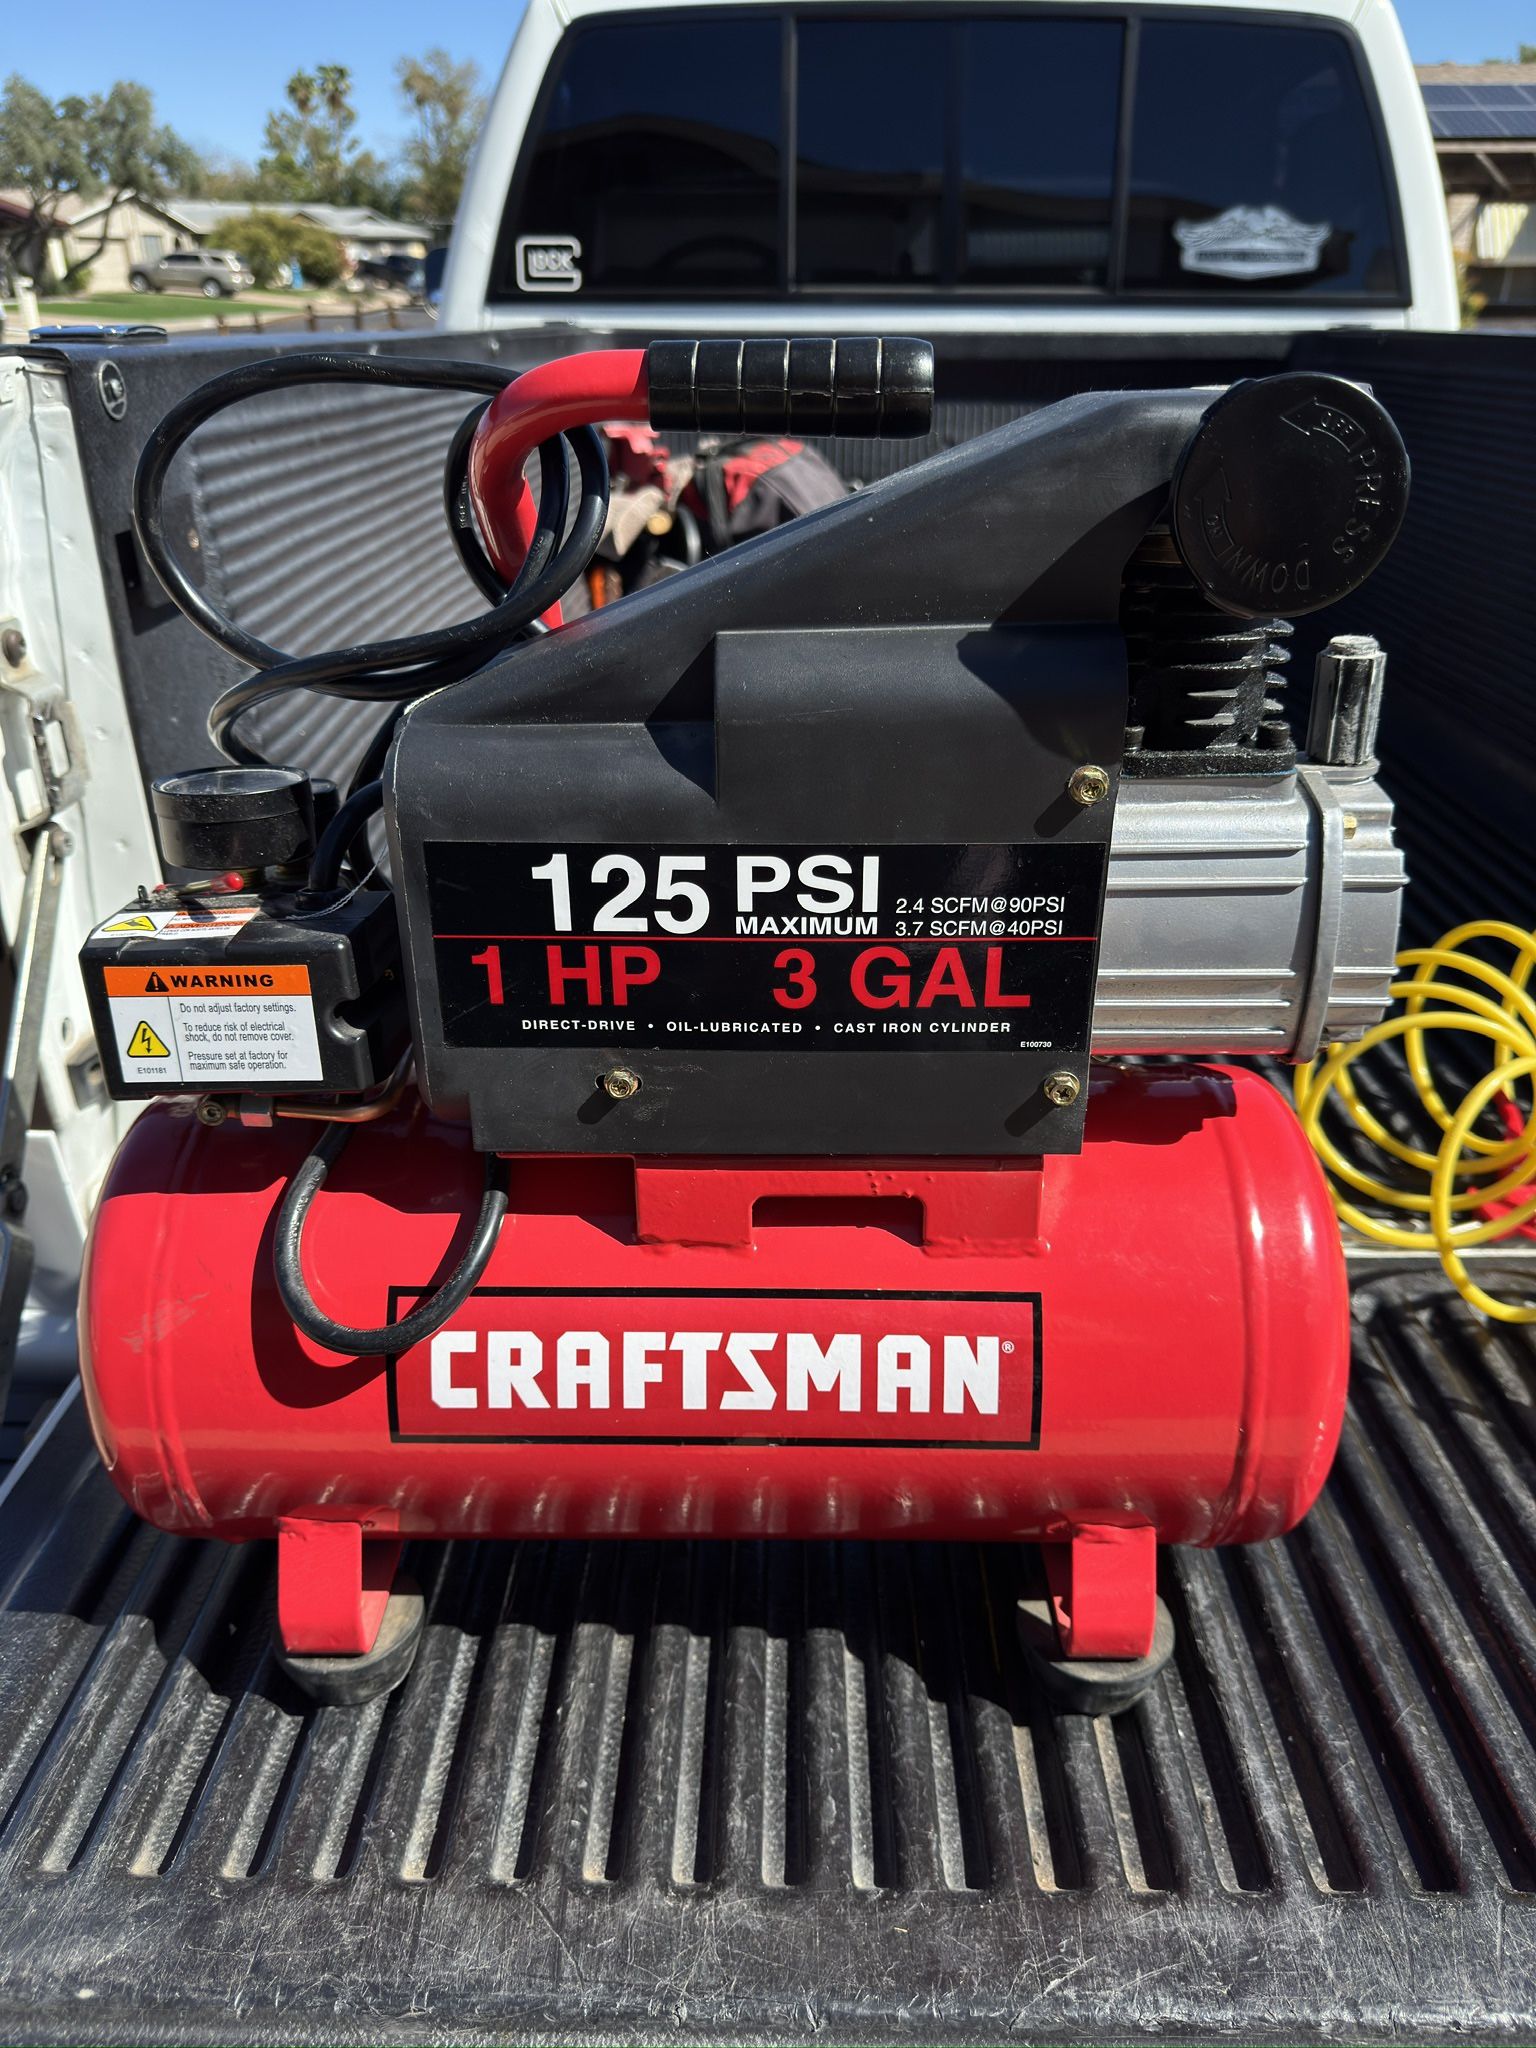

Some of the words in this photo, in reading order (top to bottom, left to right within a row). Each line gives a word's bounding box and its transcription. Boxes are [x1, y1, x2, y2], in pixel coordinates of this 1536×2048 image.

[1331, 446, 1383, 565] PRESS
[1223, 546, 1312, 594] DOWN
[531, 853, 710, 935] 125
[736, 854, 880, 914] PSI
[895, 897, 925, 914] 2.4
[930, 896, 1065, 914] SCFM@90PSI
[735, 916, 878, 936] MAXIMUM
[895, 920, 924, 937] 3.7
[929, 919, 1063, 937] SCFM@40PSI
[170, 974, 274, 988] WARNING
[471, 945, 505, 1005] 1
[546, 944, 661, 1006] HP
[772, 947, 817, 1010] 3
[849, 945, 1031, 1010] GAL
[179, 1002, 192, 1013] Do
[194, 1002, 207, 1013] not
[208, 1002, 233, 1016] adjust
[234, 1001, 261, 1015] factory
[263, 1001, 297, 1015] settings.
[182, 1022, 193, 1032] To
[194, 1022, 222, 1032] reduce
[223, 1022, 239, 1032] risk
[240, 1021, 248, 1032] of
[250, 1021, 286, 1031] electrical
[521, 1019, 636, 1031] DIRECT-DRIVE
[666, 1021, 803, 1033] OIL-LUBRICATED
[833, 1022, 876, 1034] CAST
[882, 1022, 922, 1034] IRON
[929, 1022, 1011, 1034] CYLINDER
[184, 1032, 211, 1043] shock,
[212, 1031, 223, 1042] do
[224, 1032, 238, 1042] not
[239, 1033, 269, 1042] remove
[270, 1033, 295, 1042] cover.
[1020, 1040, 1052, 1048] E100730
[187, 1051, 223, 1061] Pressure
[224, 1051, 237, 1061] set
[238, 1051, 248, 1061] at
[248, 1050, 276, 1063] factory
[276, 1050, 288, 1060] for
[189, 1062, 227, 1071] maximum
[228, 1060, 246, 1071] safe
[247, 1060, 287, 1072] operation.
